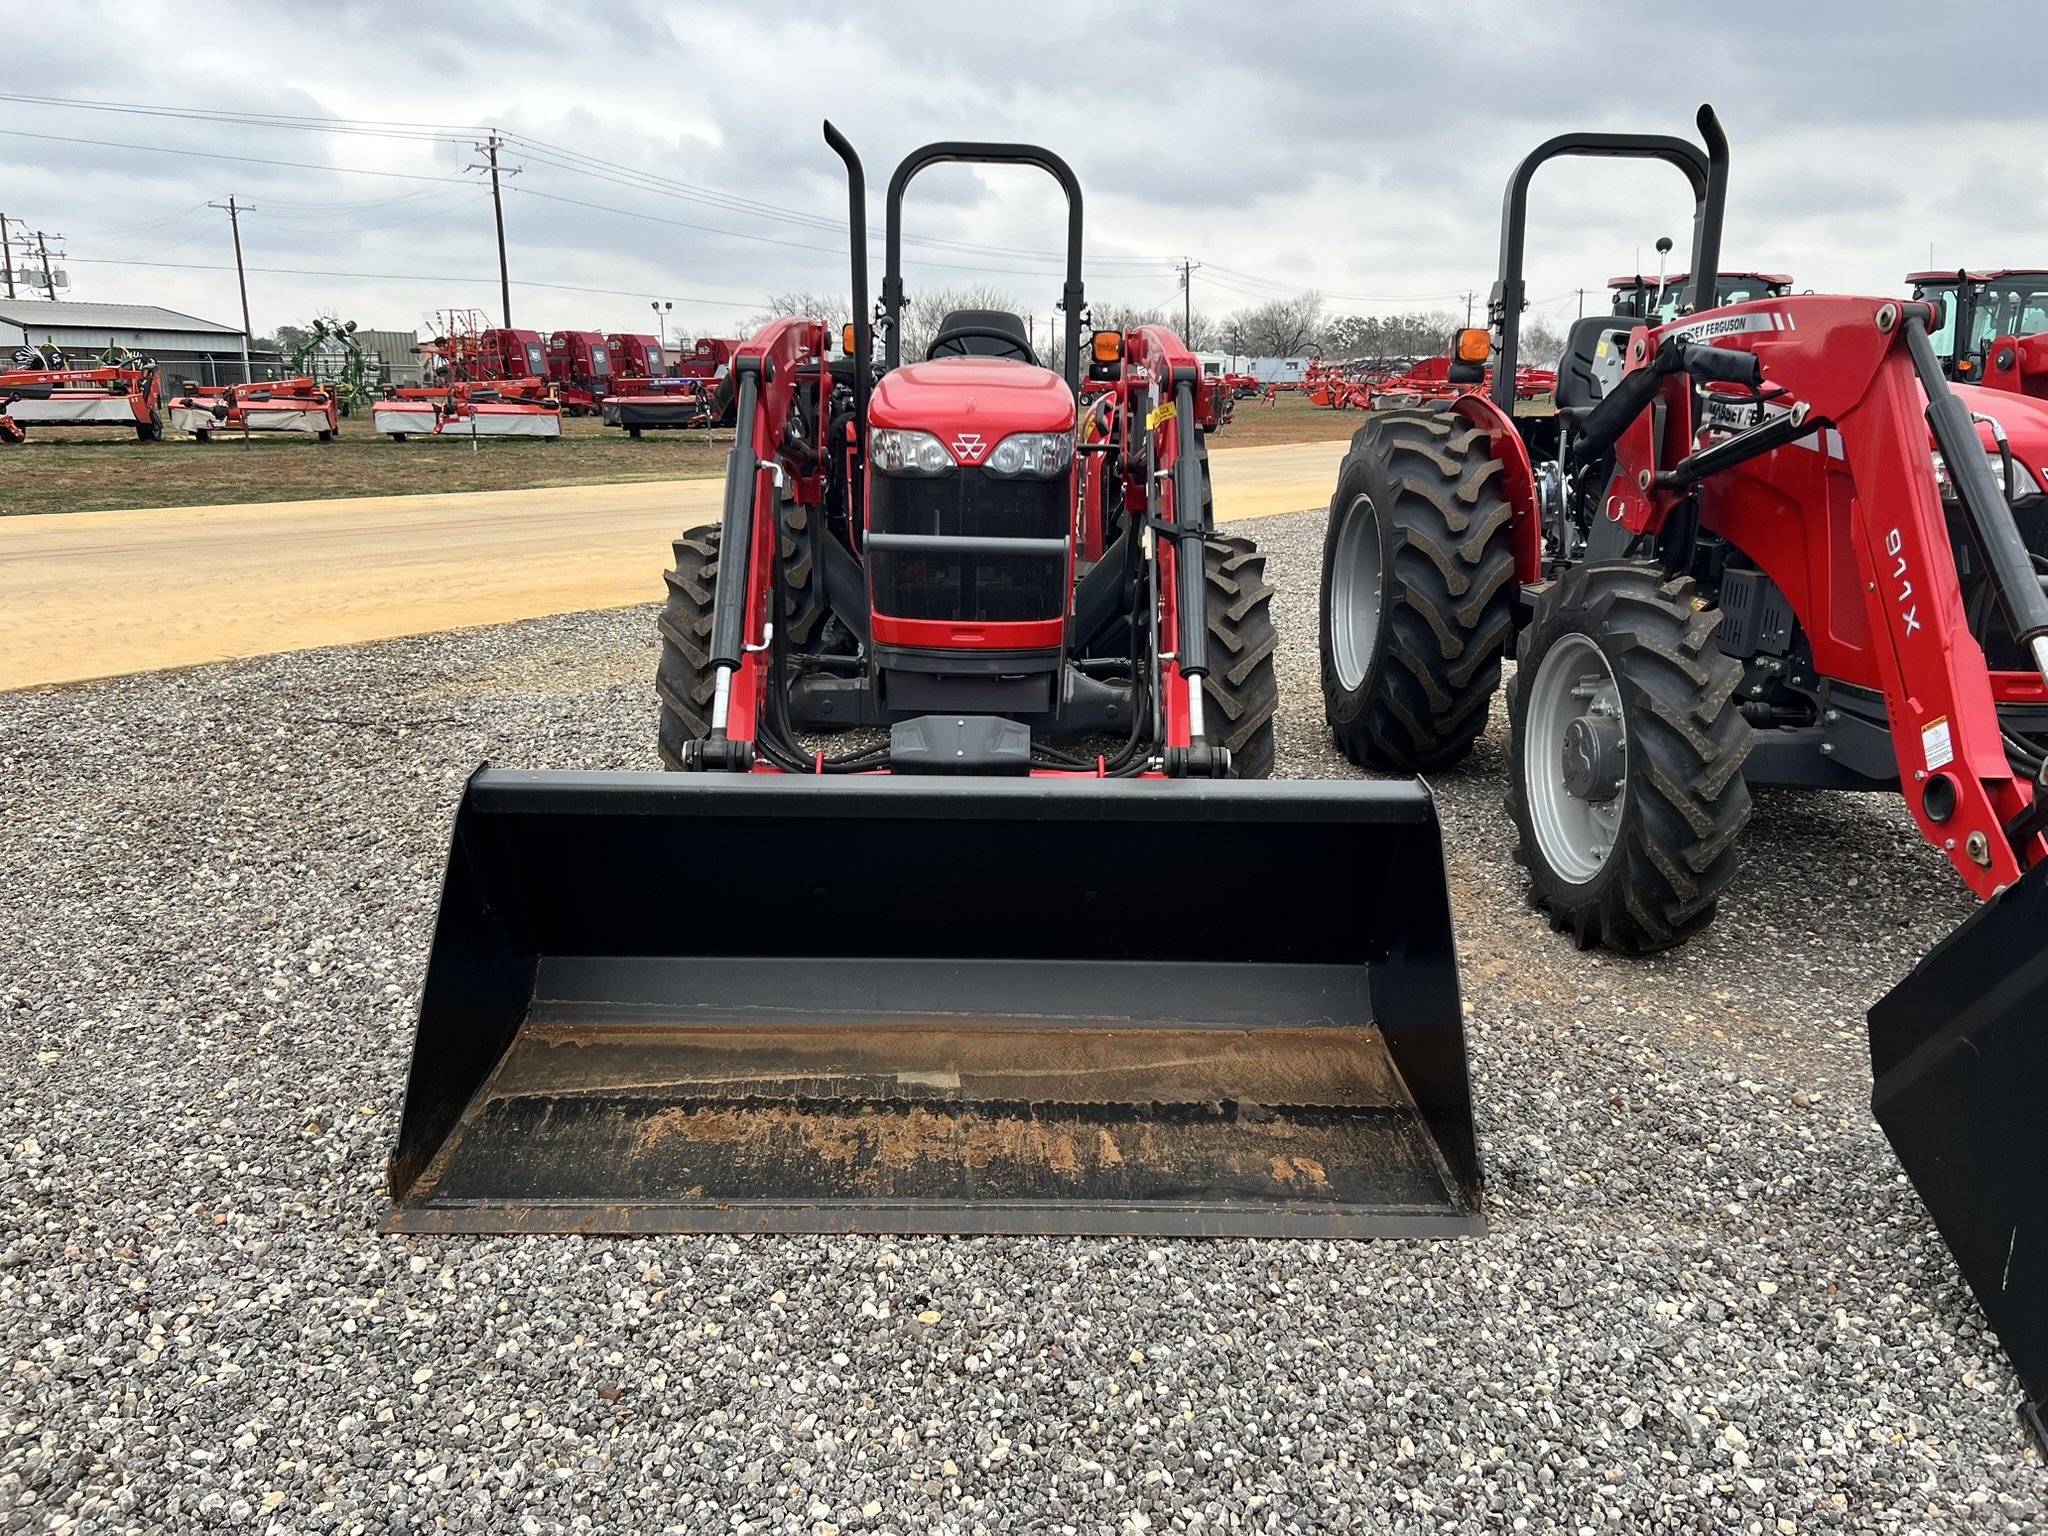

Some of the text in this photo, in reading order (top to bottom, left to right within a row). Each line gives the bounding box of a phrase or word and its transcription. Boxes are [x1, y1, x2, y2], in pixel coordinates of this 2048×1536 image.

[1705, 318, 1747, 336] FERGUSON
[1708, 402, 1744, 424] MASSEY
[1885, 528, 1921, 638] 911X
